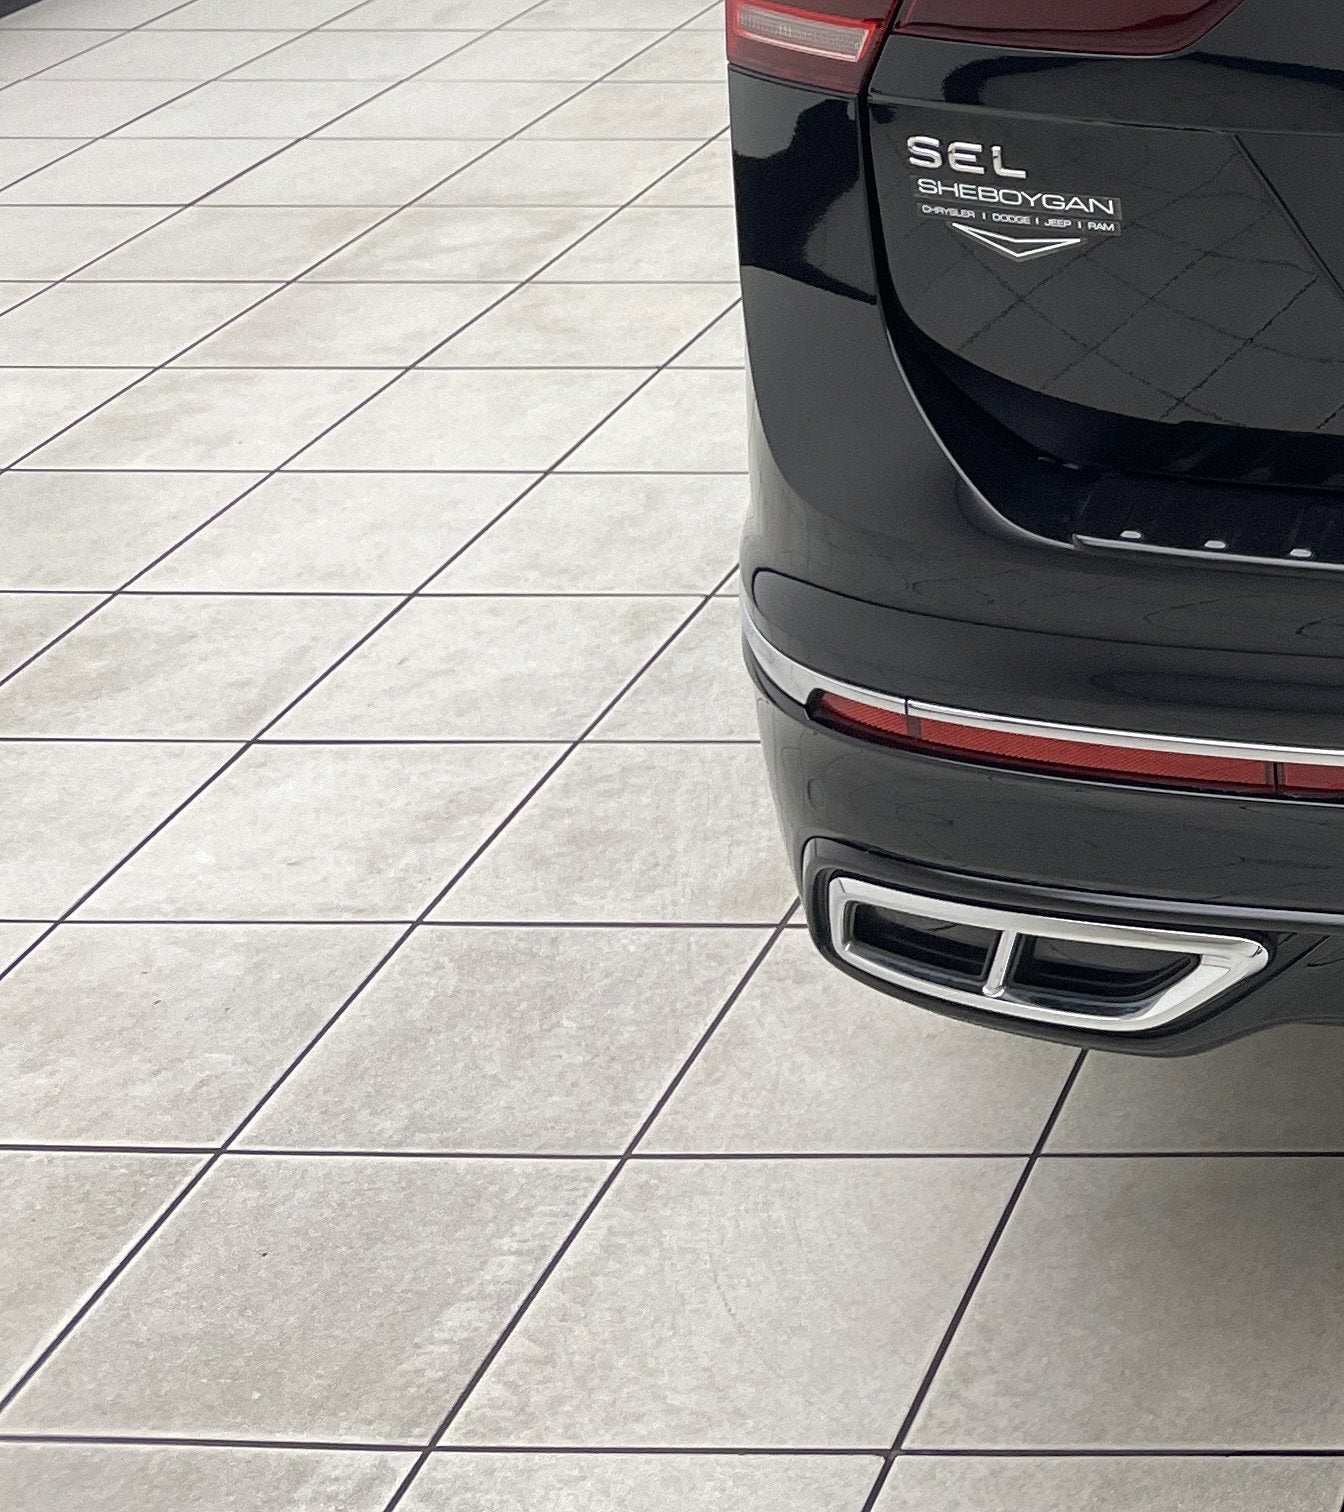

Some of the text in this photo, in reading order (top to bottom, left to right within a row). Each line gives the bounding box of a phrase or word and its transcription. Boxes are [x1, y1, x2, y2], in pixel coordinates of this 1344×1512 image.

[906, 135, 1027, 179] SEL
[916, 178, 1115, 216] SHEBOYGAN
[921, 204, 1116, 233] CHRYSLER DODGE JEEP RAM
